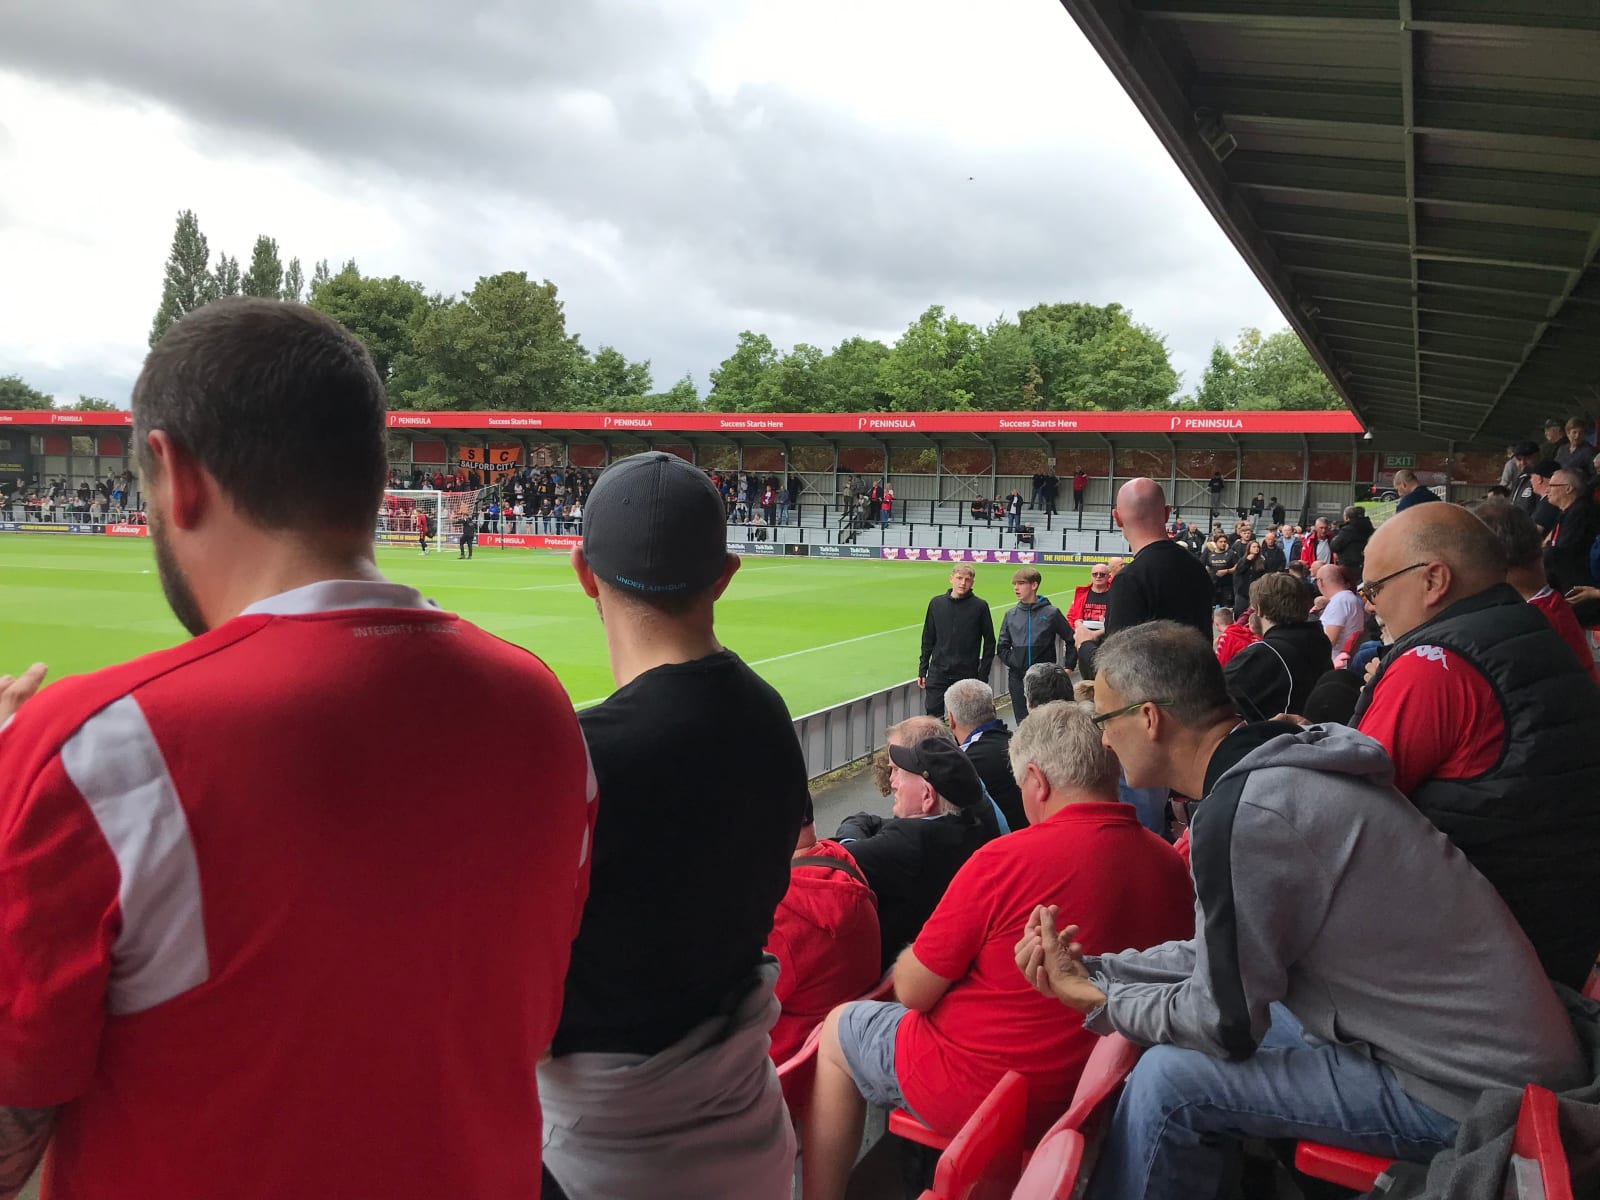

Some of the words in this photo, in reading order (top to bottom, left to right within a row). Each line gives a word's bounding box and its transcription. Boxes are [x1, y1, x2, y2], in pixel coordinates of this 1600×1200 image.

[720, 420, 746, 428] Success
[870, 420, 916, 428] PENINSULA
[999, 420, 1030, 428] Success
[1032, 420, 1056, 428] Starts
[1185, 418, 1243, 428] PENINSULA
[468, 449, 476, 460] S
[500, 451, 510, 462] C
[460, 460, 495, 470] SALFORD
[496, 462, 515, 470] CITY
[1386, 456, 1413, 466] EXIT
[544, 538, 576, 547] Protecting
[616, 575, 645, 591] UNDER
[646, 582, 686, 591] ARMOUR
[353, 624, 414, 638] INTEGRITY
